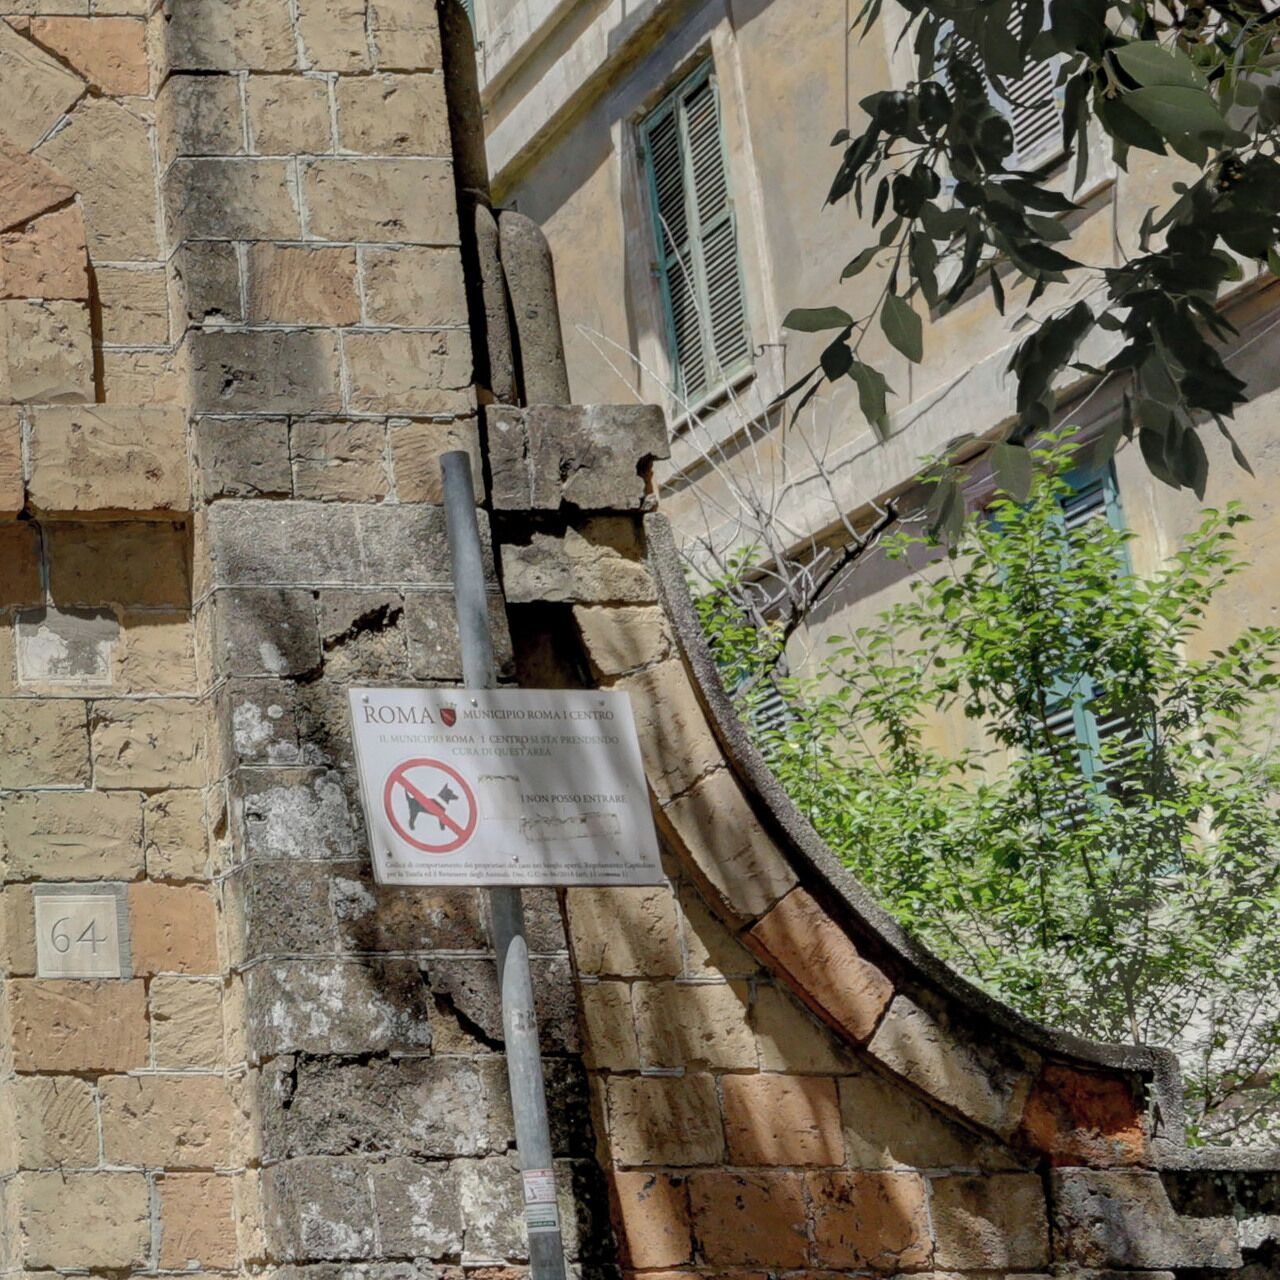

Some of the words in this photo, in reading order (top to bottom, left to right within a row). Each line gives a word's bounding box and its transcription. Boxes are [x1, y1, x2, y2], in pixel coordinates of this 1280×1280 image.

[363, 705, 436, 725] ROMA
[463, 709, 525, 721] MUNICIPIO
[527, 710, 561, 721] ROMA
[569, 710, 614, 721] CENTRO
[390, 735, 443, 743] MUNICIPIO
[446, 735, 475, 744] ROMA
[489, 735, 529, 745] CENTRO
[560, 735, 620, 745] PRENDENDO
[452, 747, 480, 756] CURA
[482, 747, 493, 757] DI
[526, 793, 550, 804] NON
[551, 793, 582, 804] POSSO
[583, 793, 626, 804] ENTRARE
[51, 917, 108, 955] 64
